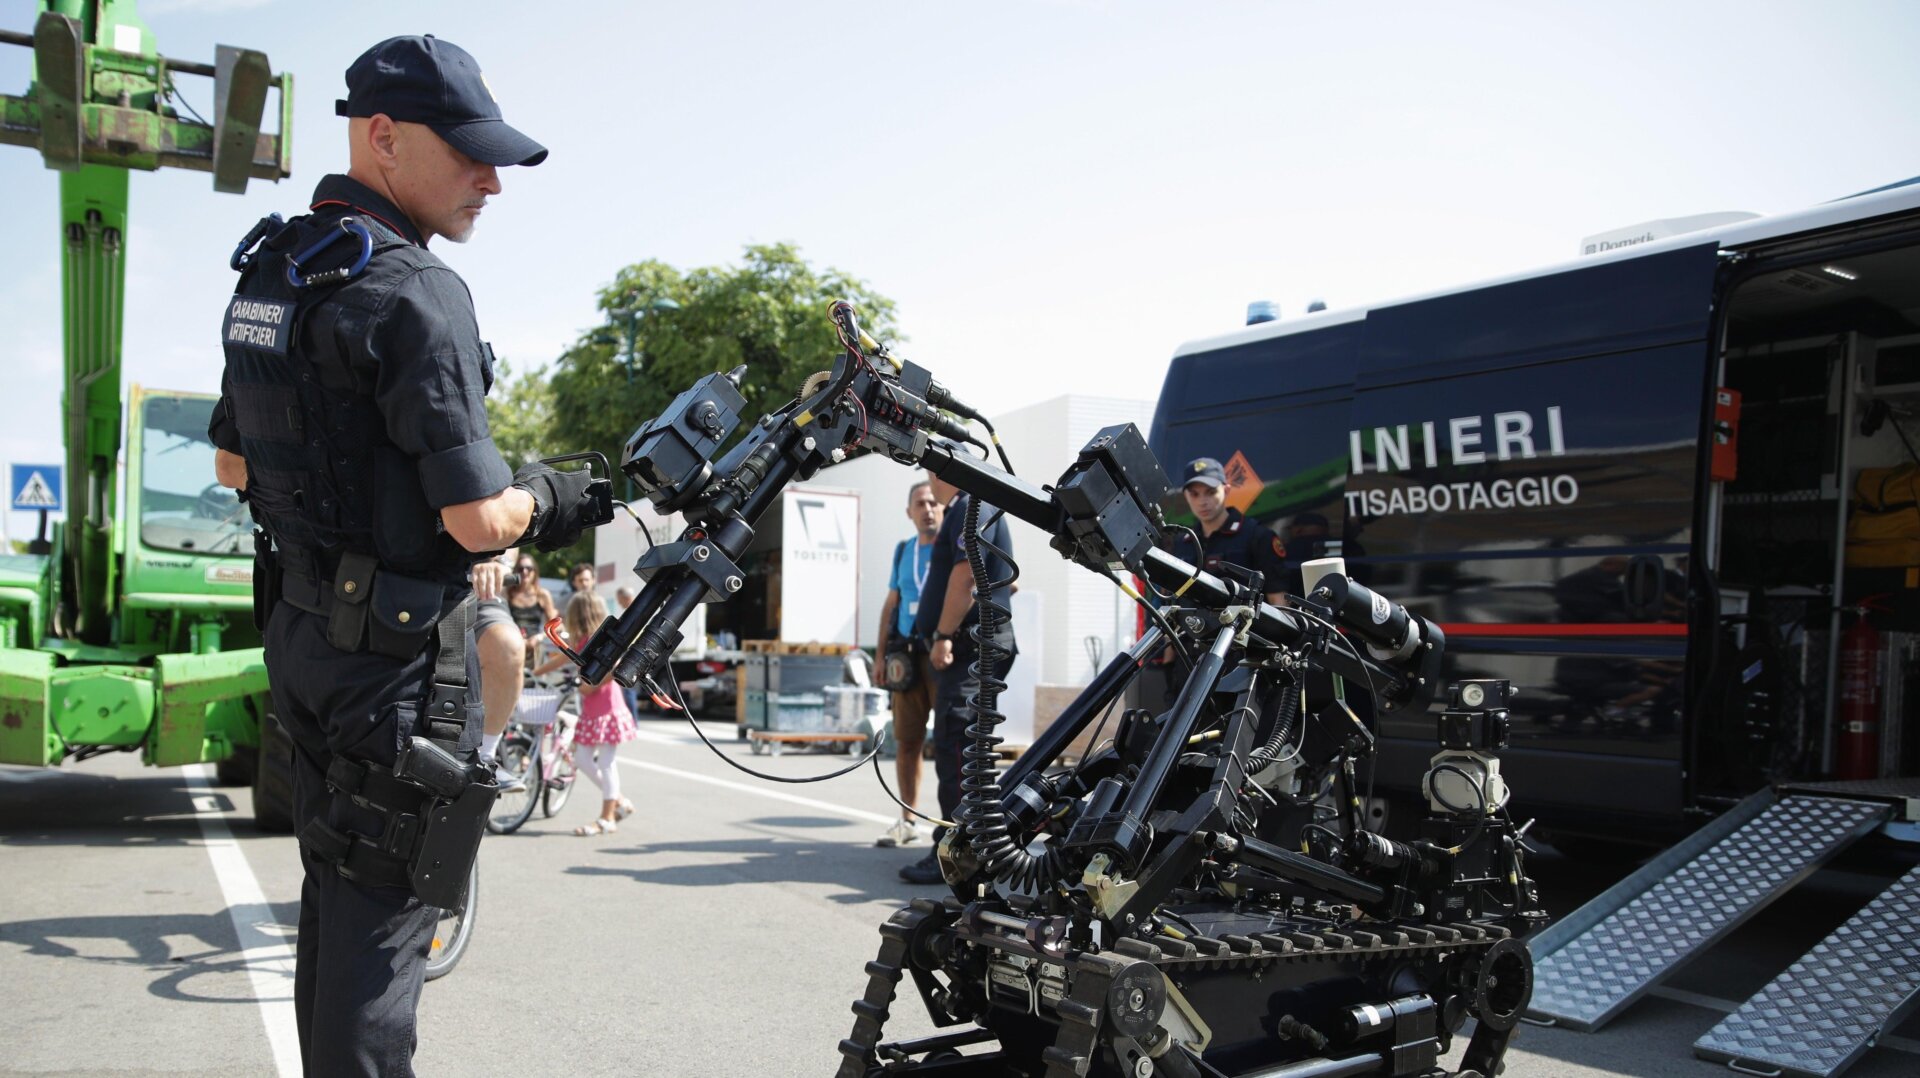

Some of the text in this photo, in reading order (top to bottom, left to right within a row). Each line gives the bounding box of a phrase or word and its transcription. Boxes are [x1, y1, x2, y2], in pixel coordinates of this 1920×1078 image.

[231, 301, 285, 324] CARABINIERI
[228, 322, 276, 347] ARTIFICIERI
[1349, 405, 1566, 475] INIERI
[1344, 474, 1579, 517] TISABOTAGGIO
